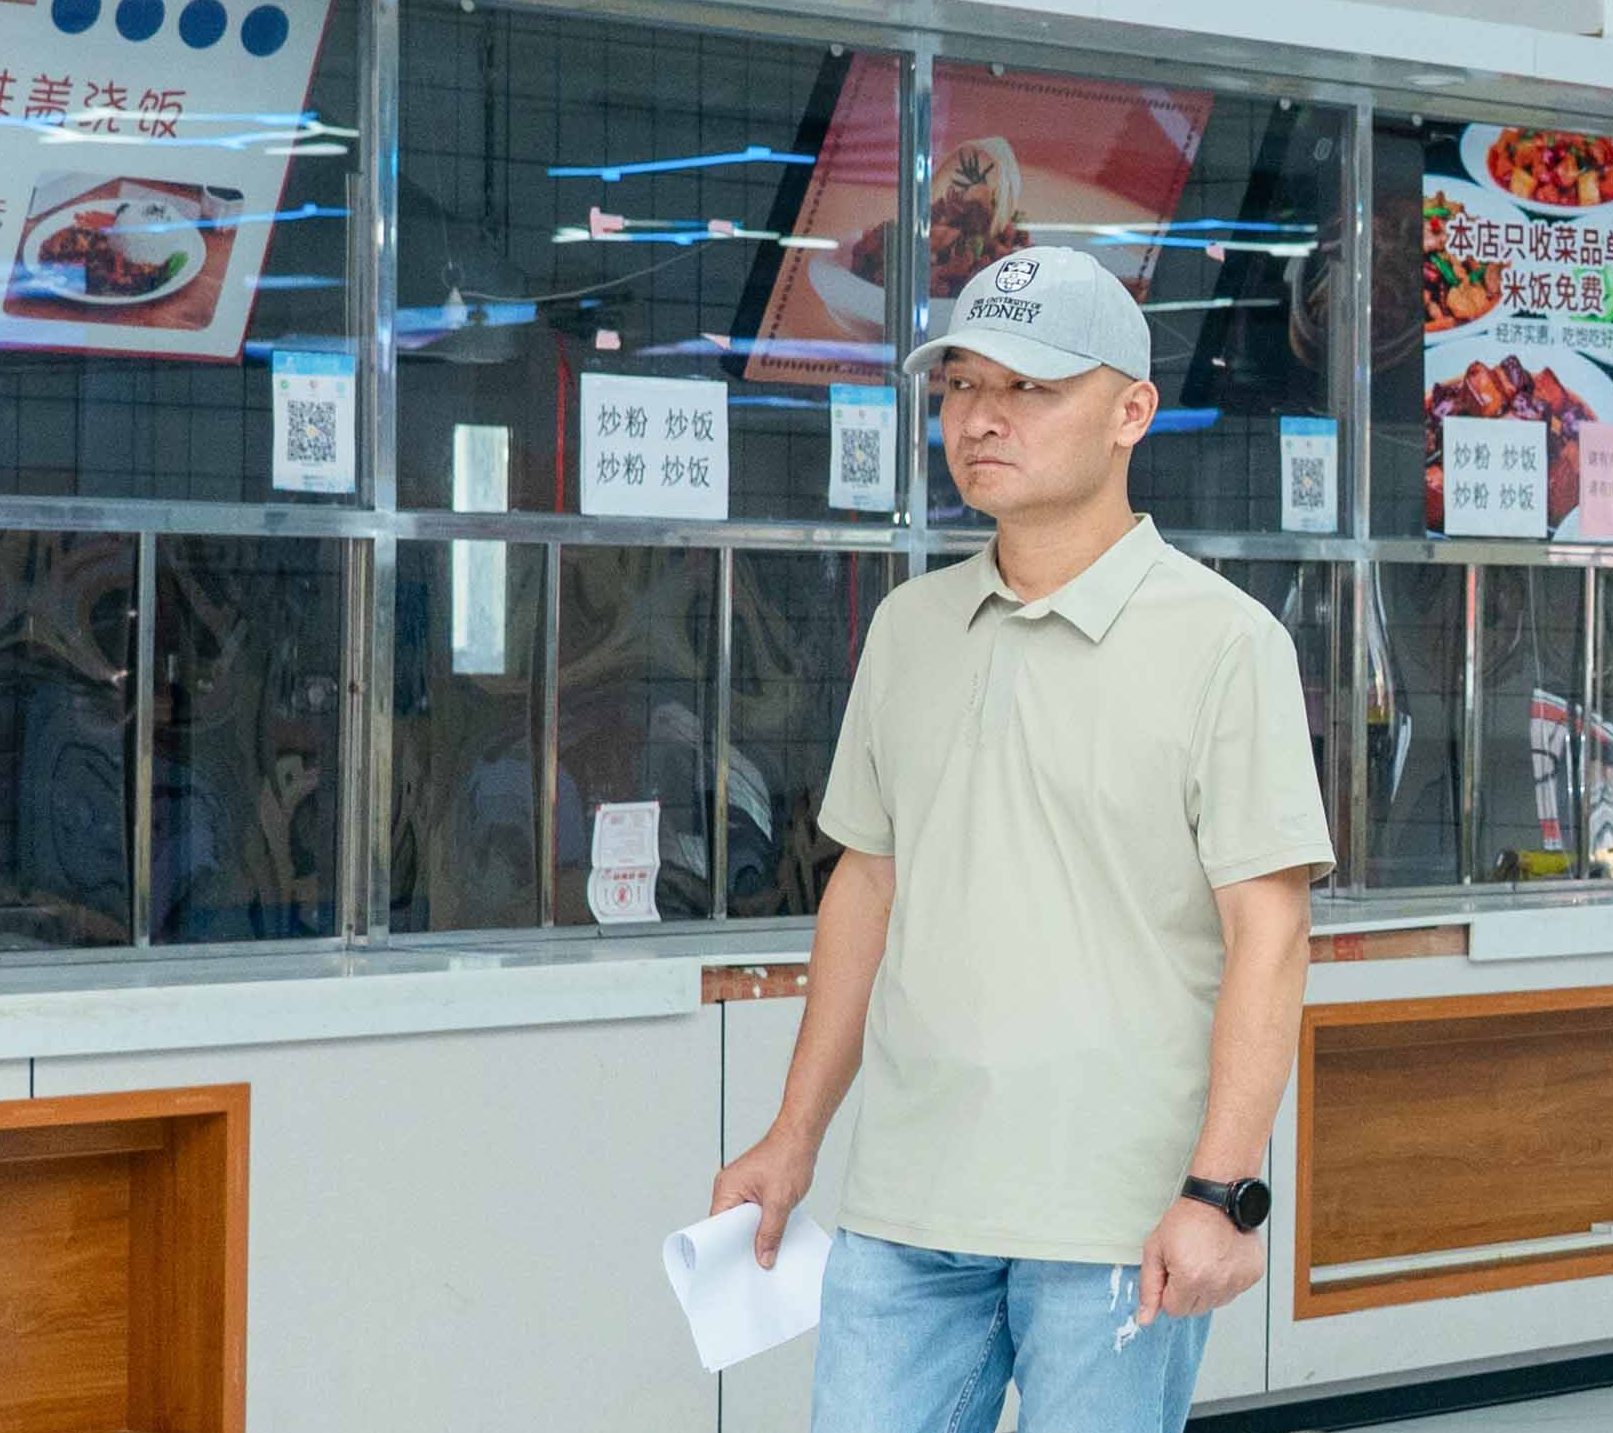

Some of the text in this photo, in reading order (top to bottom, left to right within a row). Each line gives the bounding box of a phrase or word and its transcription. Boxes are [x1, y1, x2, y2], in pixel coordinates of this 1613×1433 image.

[973, 296, 1042, 310] THE UNIVERSITY OF
[1502, 270, 1606, 313] 米饭免费
[966, 304, 1041, 324] SYDNEY
[596, 404, 715, 445] 炒粉 炒饭
[595, 452, 712, 489] 炒粉 炒饭
[1451, 441, 1538, 473] 炒粉 炒饭
[1451, 480, 1536, 512] 炒粉 炒饭
